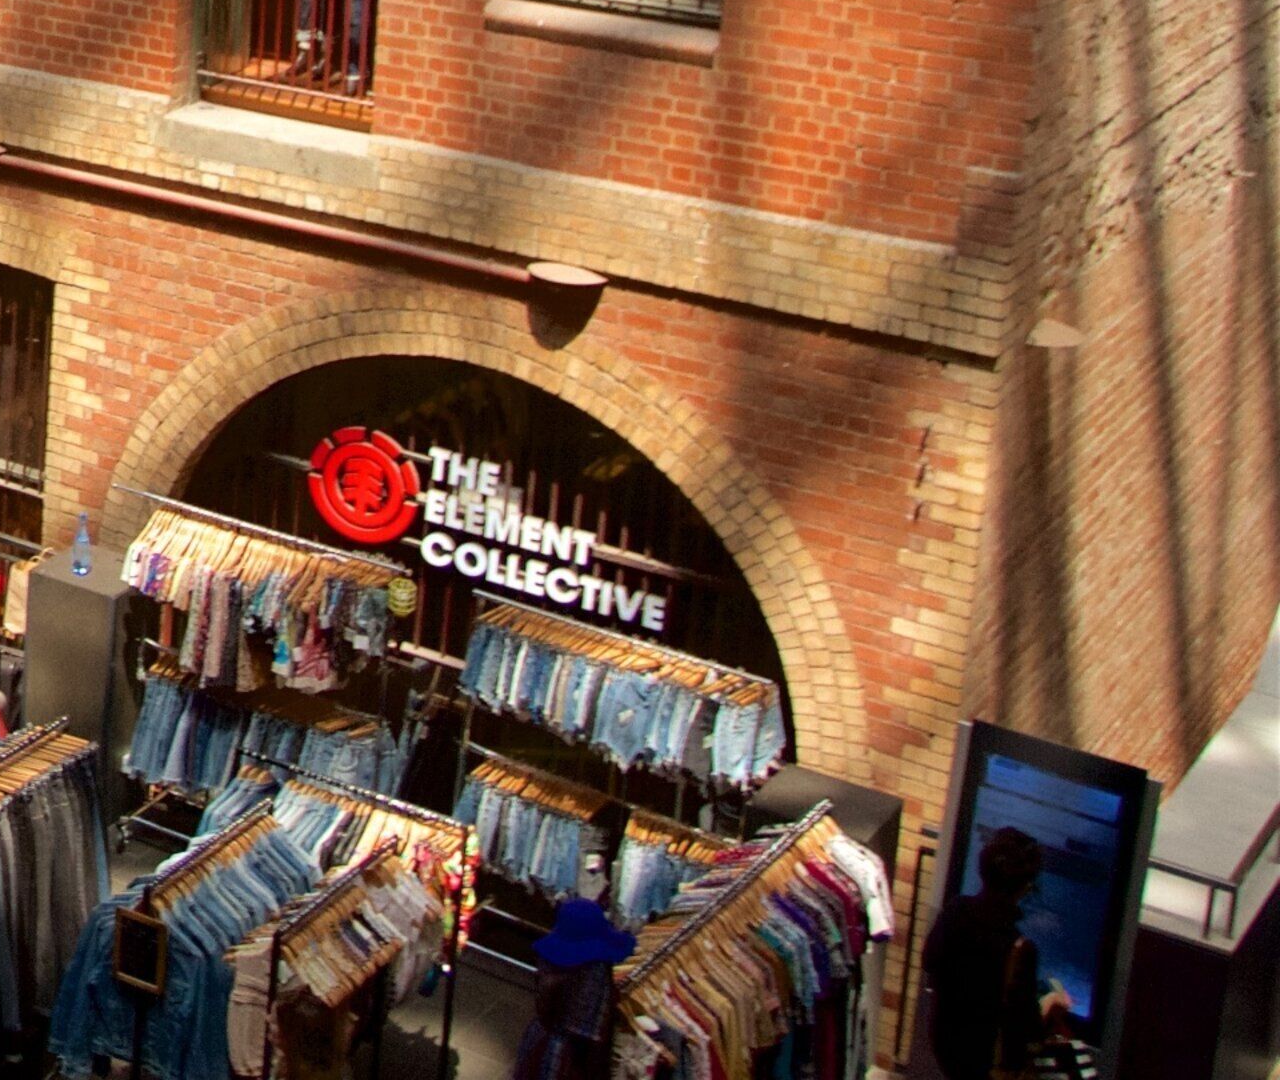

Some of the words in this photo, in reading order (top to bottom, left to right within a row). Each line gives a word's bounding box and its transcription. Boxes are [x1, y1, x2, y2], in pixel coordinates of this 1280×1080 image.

[427, 446, 501, 497] THE
[423, 488, 597, 566] ELEMENT
[419, 531, 669, 633] COLLECTIVE
